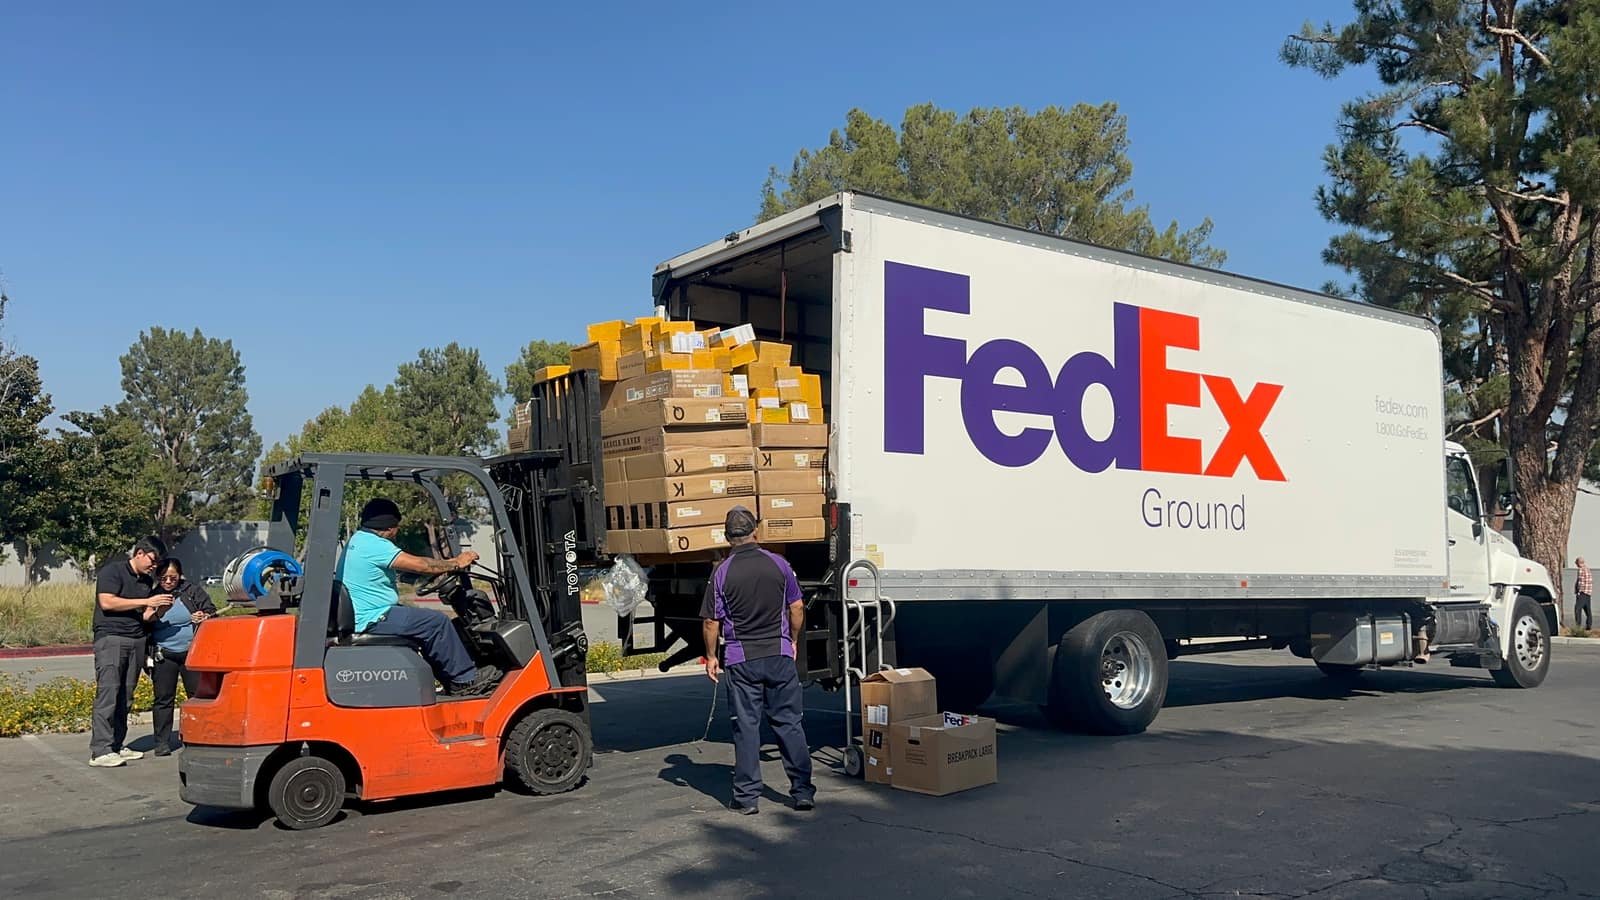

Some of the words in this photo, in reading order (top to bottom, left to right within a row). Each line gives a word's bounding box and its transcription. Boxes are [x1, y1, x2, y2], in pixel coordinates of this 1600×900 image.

[884, 260, 1288, 482] FedEx
[1375, 394, 1429, 418] fedex.com
[1141, 488, 1245, 530] Ground
[564, 530, 579, 596] TOYOTA
[354, 669, 408, 682] TOYOTA
